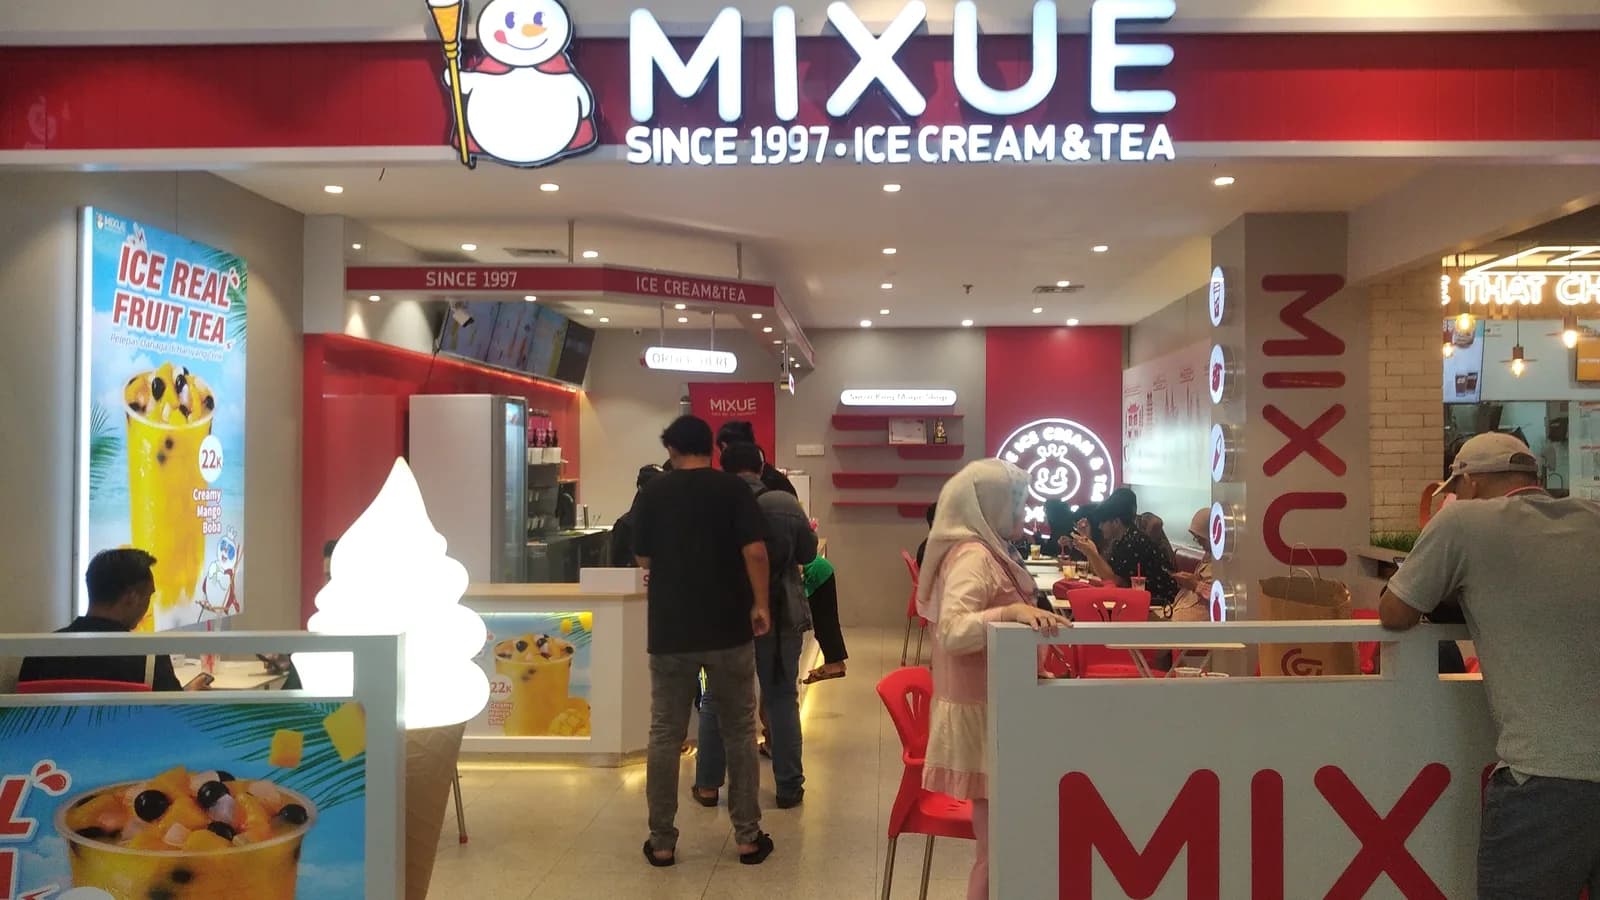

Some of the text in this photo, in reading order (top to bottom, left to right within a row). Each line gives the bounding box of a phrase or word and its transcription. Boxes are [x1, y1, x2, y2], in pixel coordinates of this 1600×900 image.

[629, 0, 1177, 122] MIXUE
[625, 126, 739, 165] SINCE
[750, 125, 830, 164] 1997
[854, 124, 912, 164] ICE
[118, 245, 230, 309] ICE REAL
[426, 271, 518, 288] SINCE 1997
[636, 275, 747, 303] ICE CREAM&TEA
[1459, 275, 1546, 306] THAT
[112, 291, 225, 344] FRUIT TEA
[710, 397, 757, 412] MIXUE
[193, 488, 222, 504] Creamy
[197, 505, 221, 521] Mango
[202, 521, 221, 535] Boba
[1058, 762, 1497, 900] MIX
